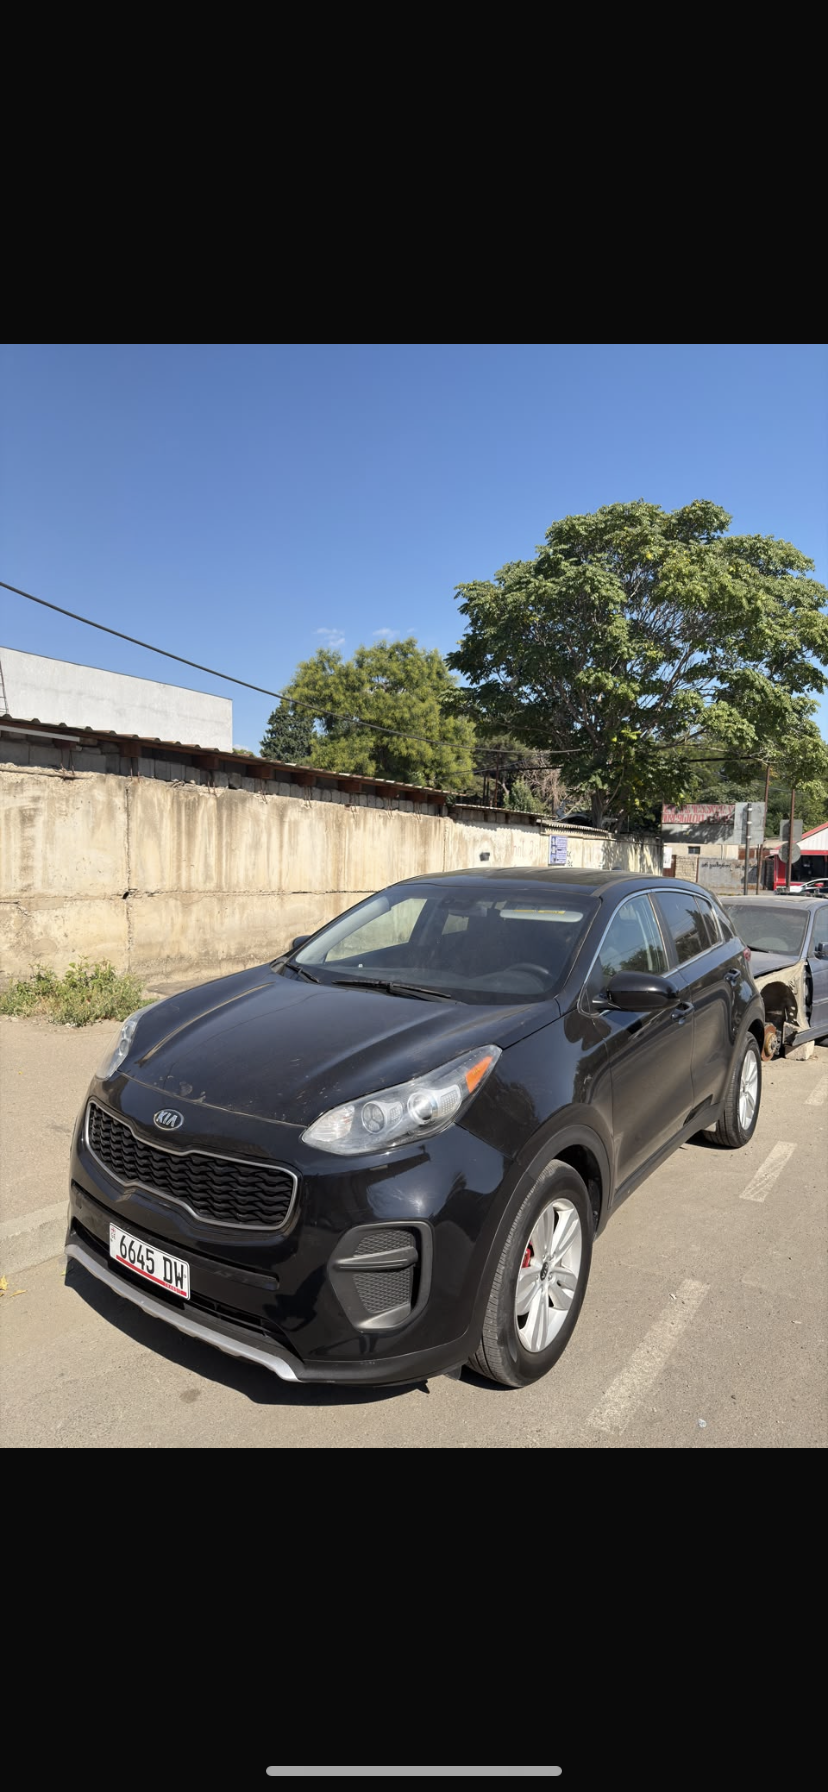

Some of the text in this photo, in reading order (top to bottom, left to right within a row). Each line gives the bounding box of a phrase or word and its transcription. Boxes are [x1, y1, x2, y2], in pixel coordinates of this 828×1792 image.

[156, 1110, 178, 1127] KIA
[119, 1235, 184, 1290] 6645 DW
